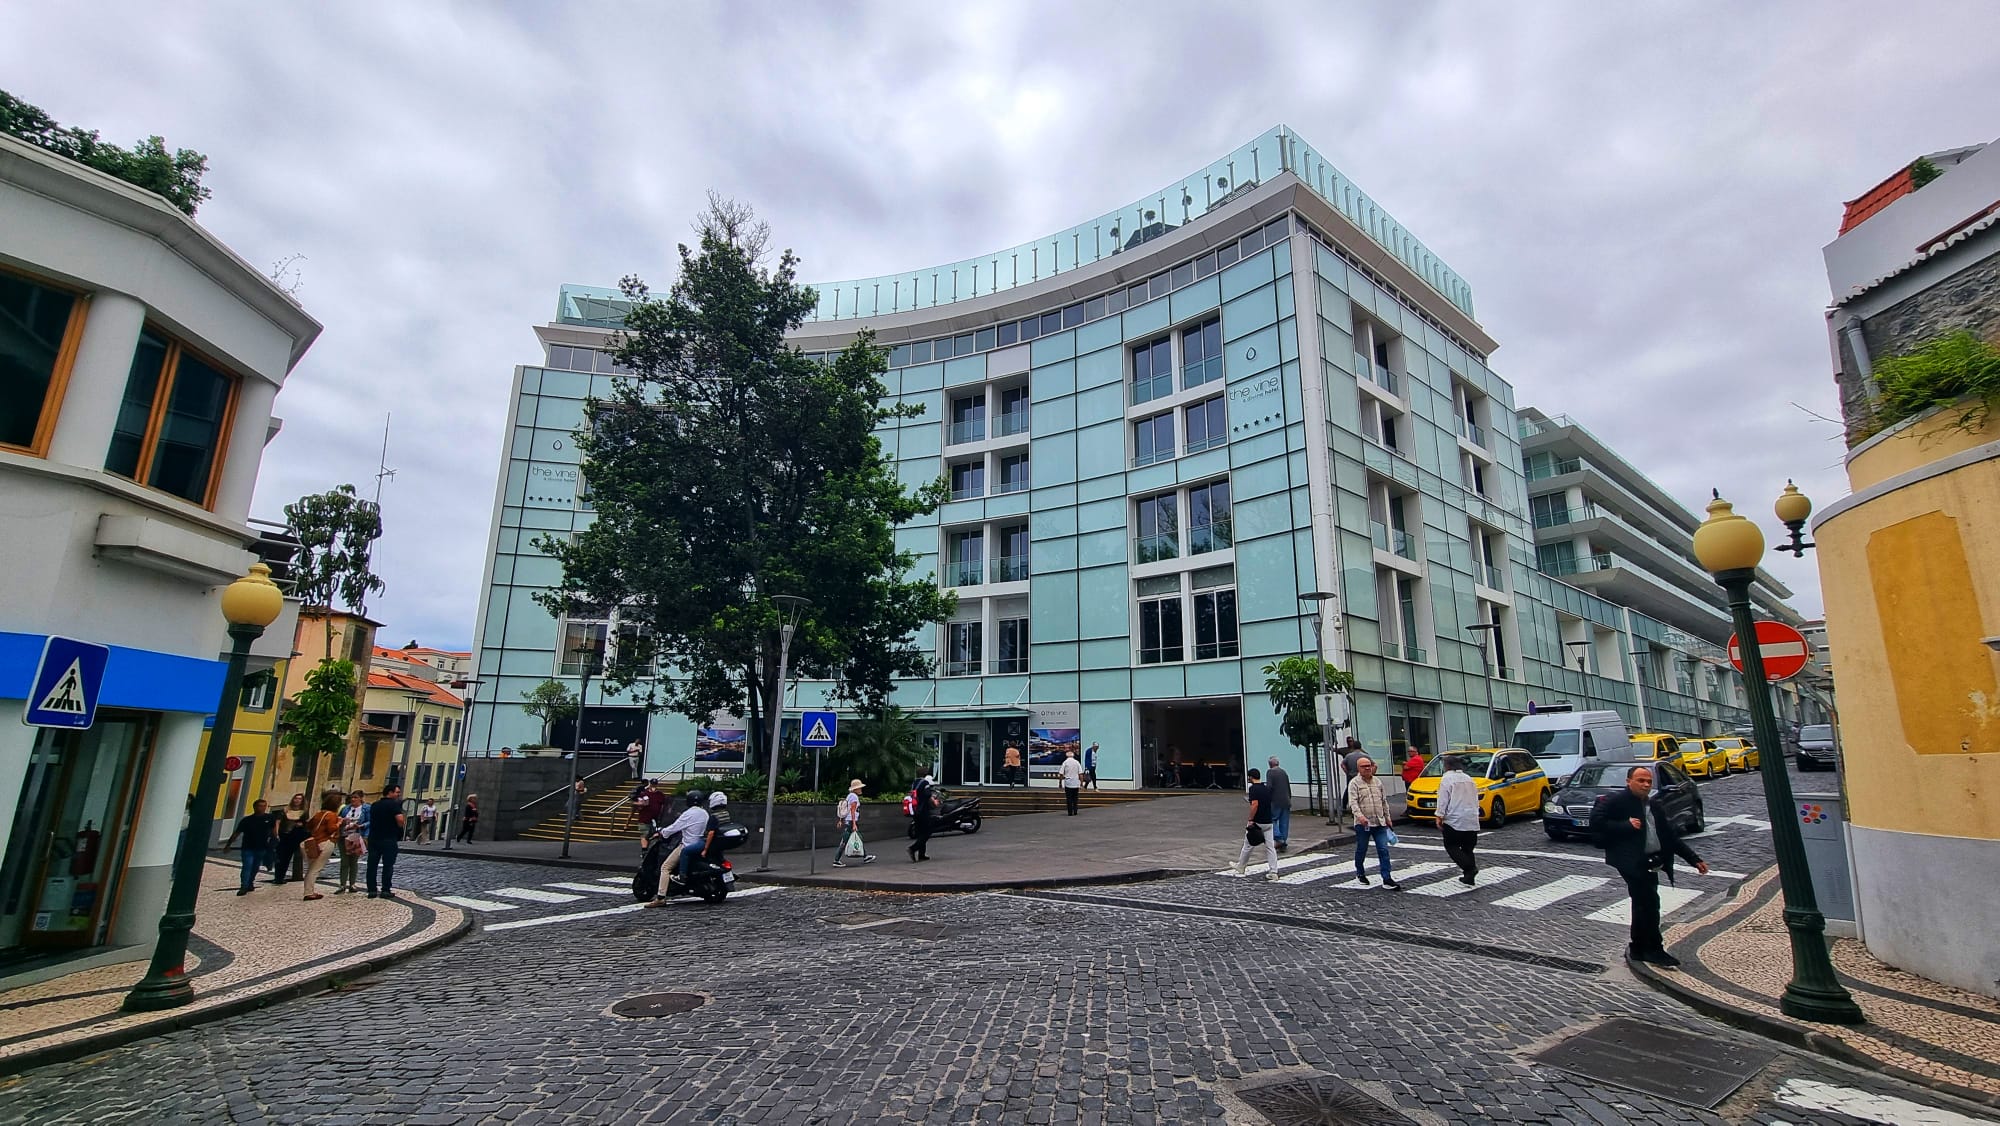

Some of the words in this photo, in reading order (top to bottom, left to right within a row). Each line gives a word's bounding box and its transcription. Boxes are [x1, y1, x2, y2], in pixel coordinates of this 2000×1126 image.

[1230, 387, 1250, 401] the
[1253, 377, 1278, 392] vine
[532, 465, 552, 477] the
[554, 469, 577, 479] vine
